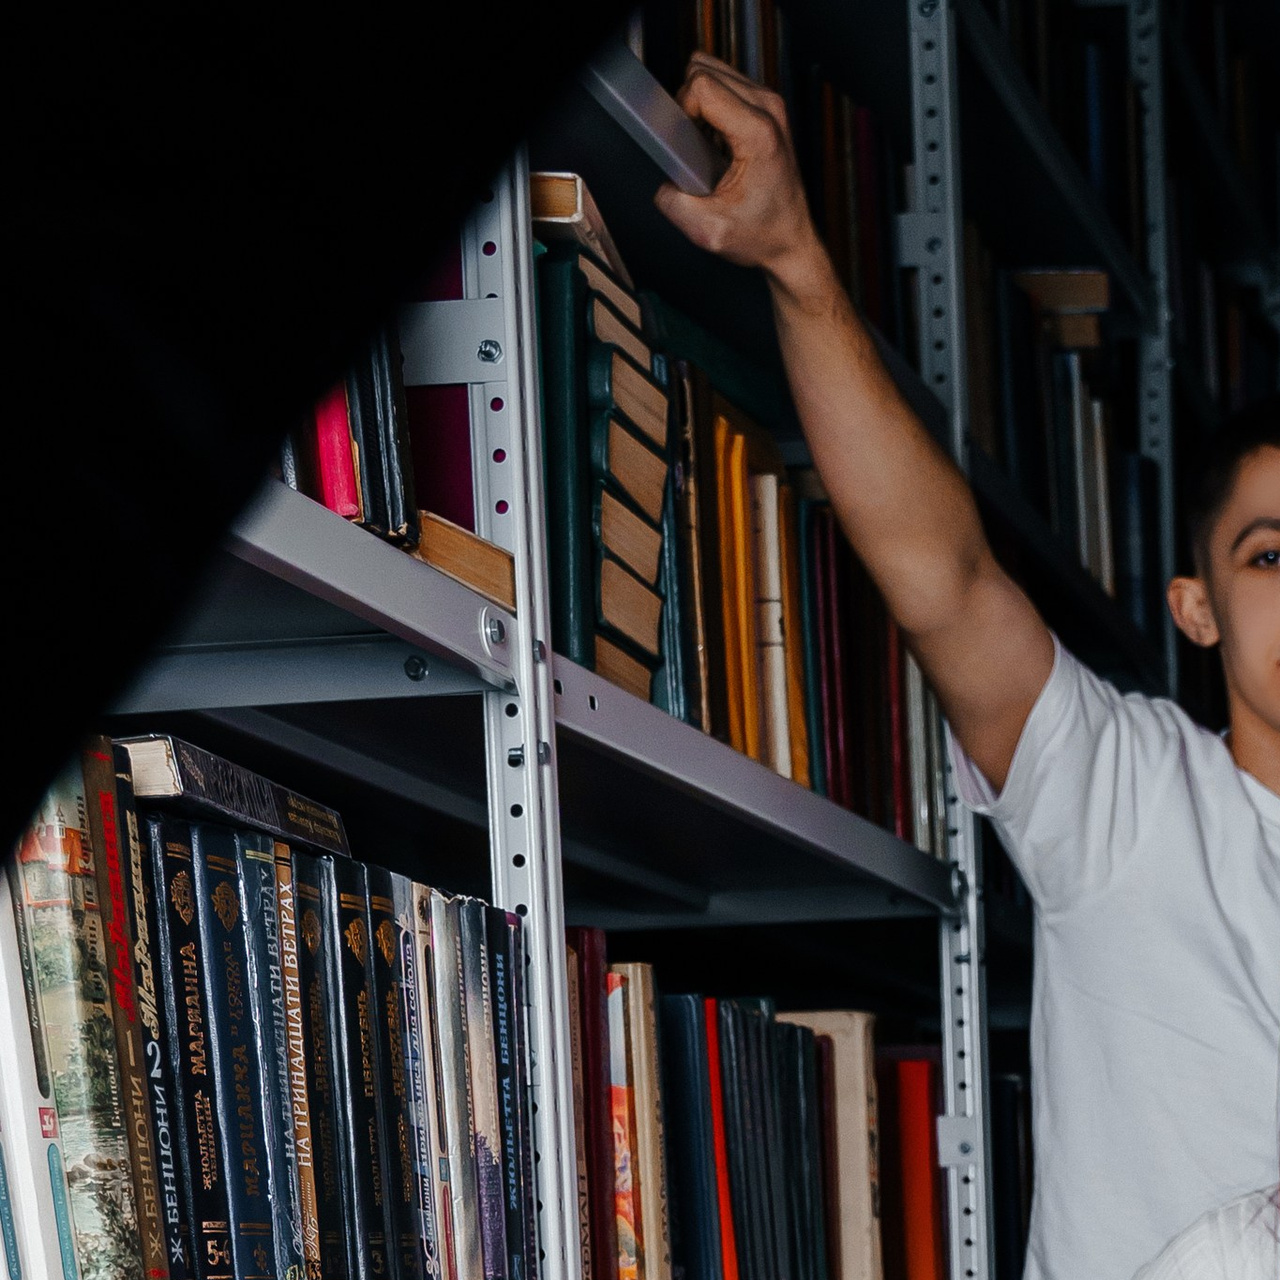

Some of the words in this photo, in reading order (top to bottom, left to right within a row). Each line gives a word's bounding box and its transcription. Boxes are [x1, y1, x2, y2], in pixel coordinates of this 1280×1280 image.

[279, 881, 298, 971] ВЕТРАХ
[146, 1040, 163, 1079] 2
[179, 940, 208, 1077] МАРИАННА
[284, 976, 311, 1134] ТРИНАДЦАТИ
[356, 989, 374, 1097] ПЕРСТЕНЬ
[495, 952, 511, 1066] БЕНЦОНИ
[194, 1088, 213, 1191] ЖЮЛЬЕТТА
[297, 1136, 313, 1168] НА
[502, 1075, 519, 1211] ЖЮЛЬЕТТА
